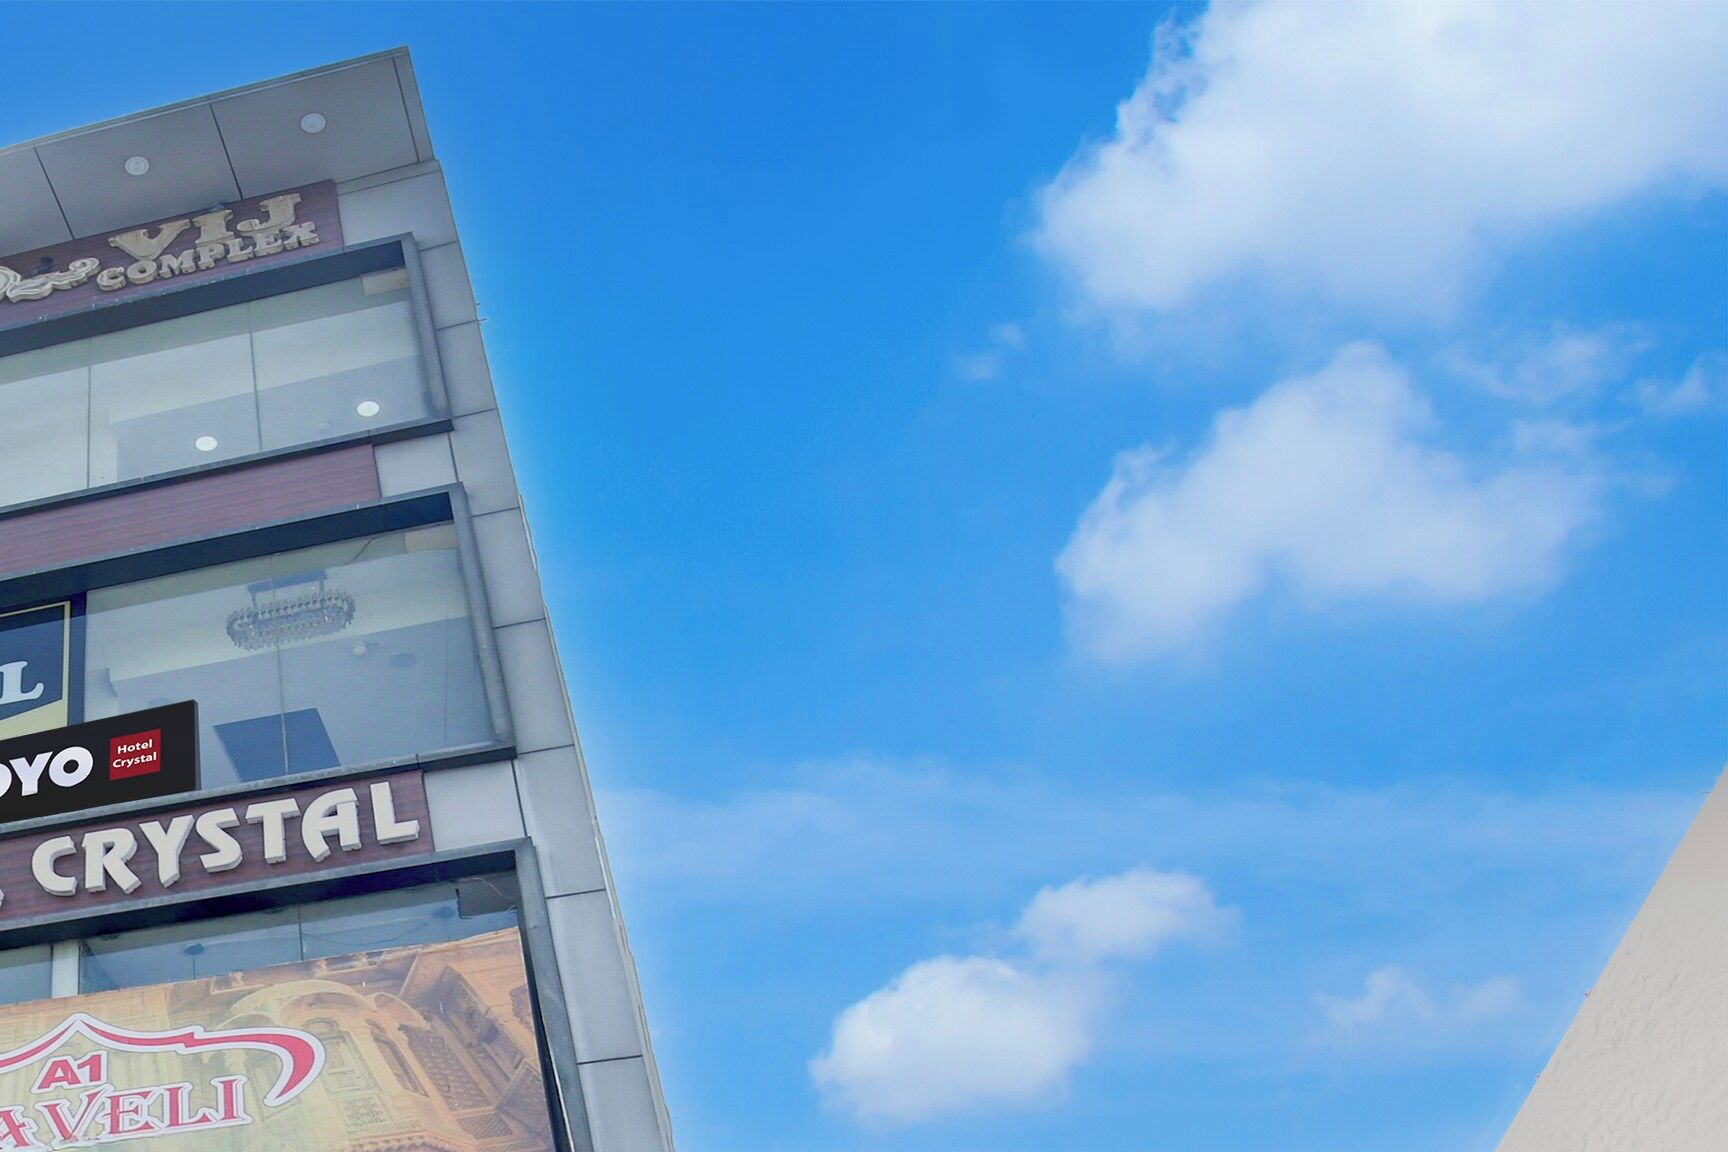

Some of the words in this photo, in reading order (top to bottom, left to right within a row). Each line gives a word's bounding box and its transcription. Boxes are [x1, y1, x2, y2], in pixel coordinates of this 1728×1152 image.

[108, 193, 302, 261] VIJ
[95, 221, 320, 291] COMPLEX
[112, 751, 158, 769] Crystal
[116, 738, 154, 755] Hotel
[30, 781, 421, 902] CRYSTAL
[35, 1052, 104, 1091] A1
